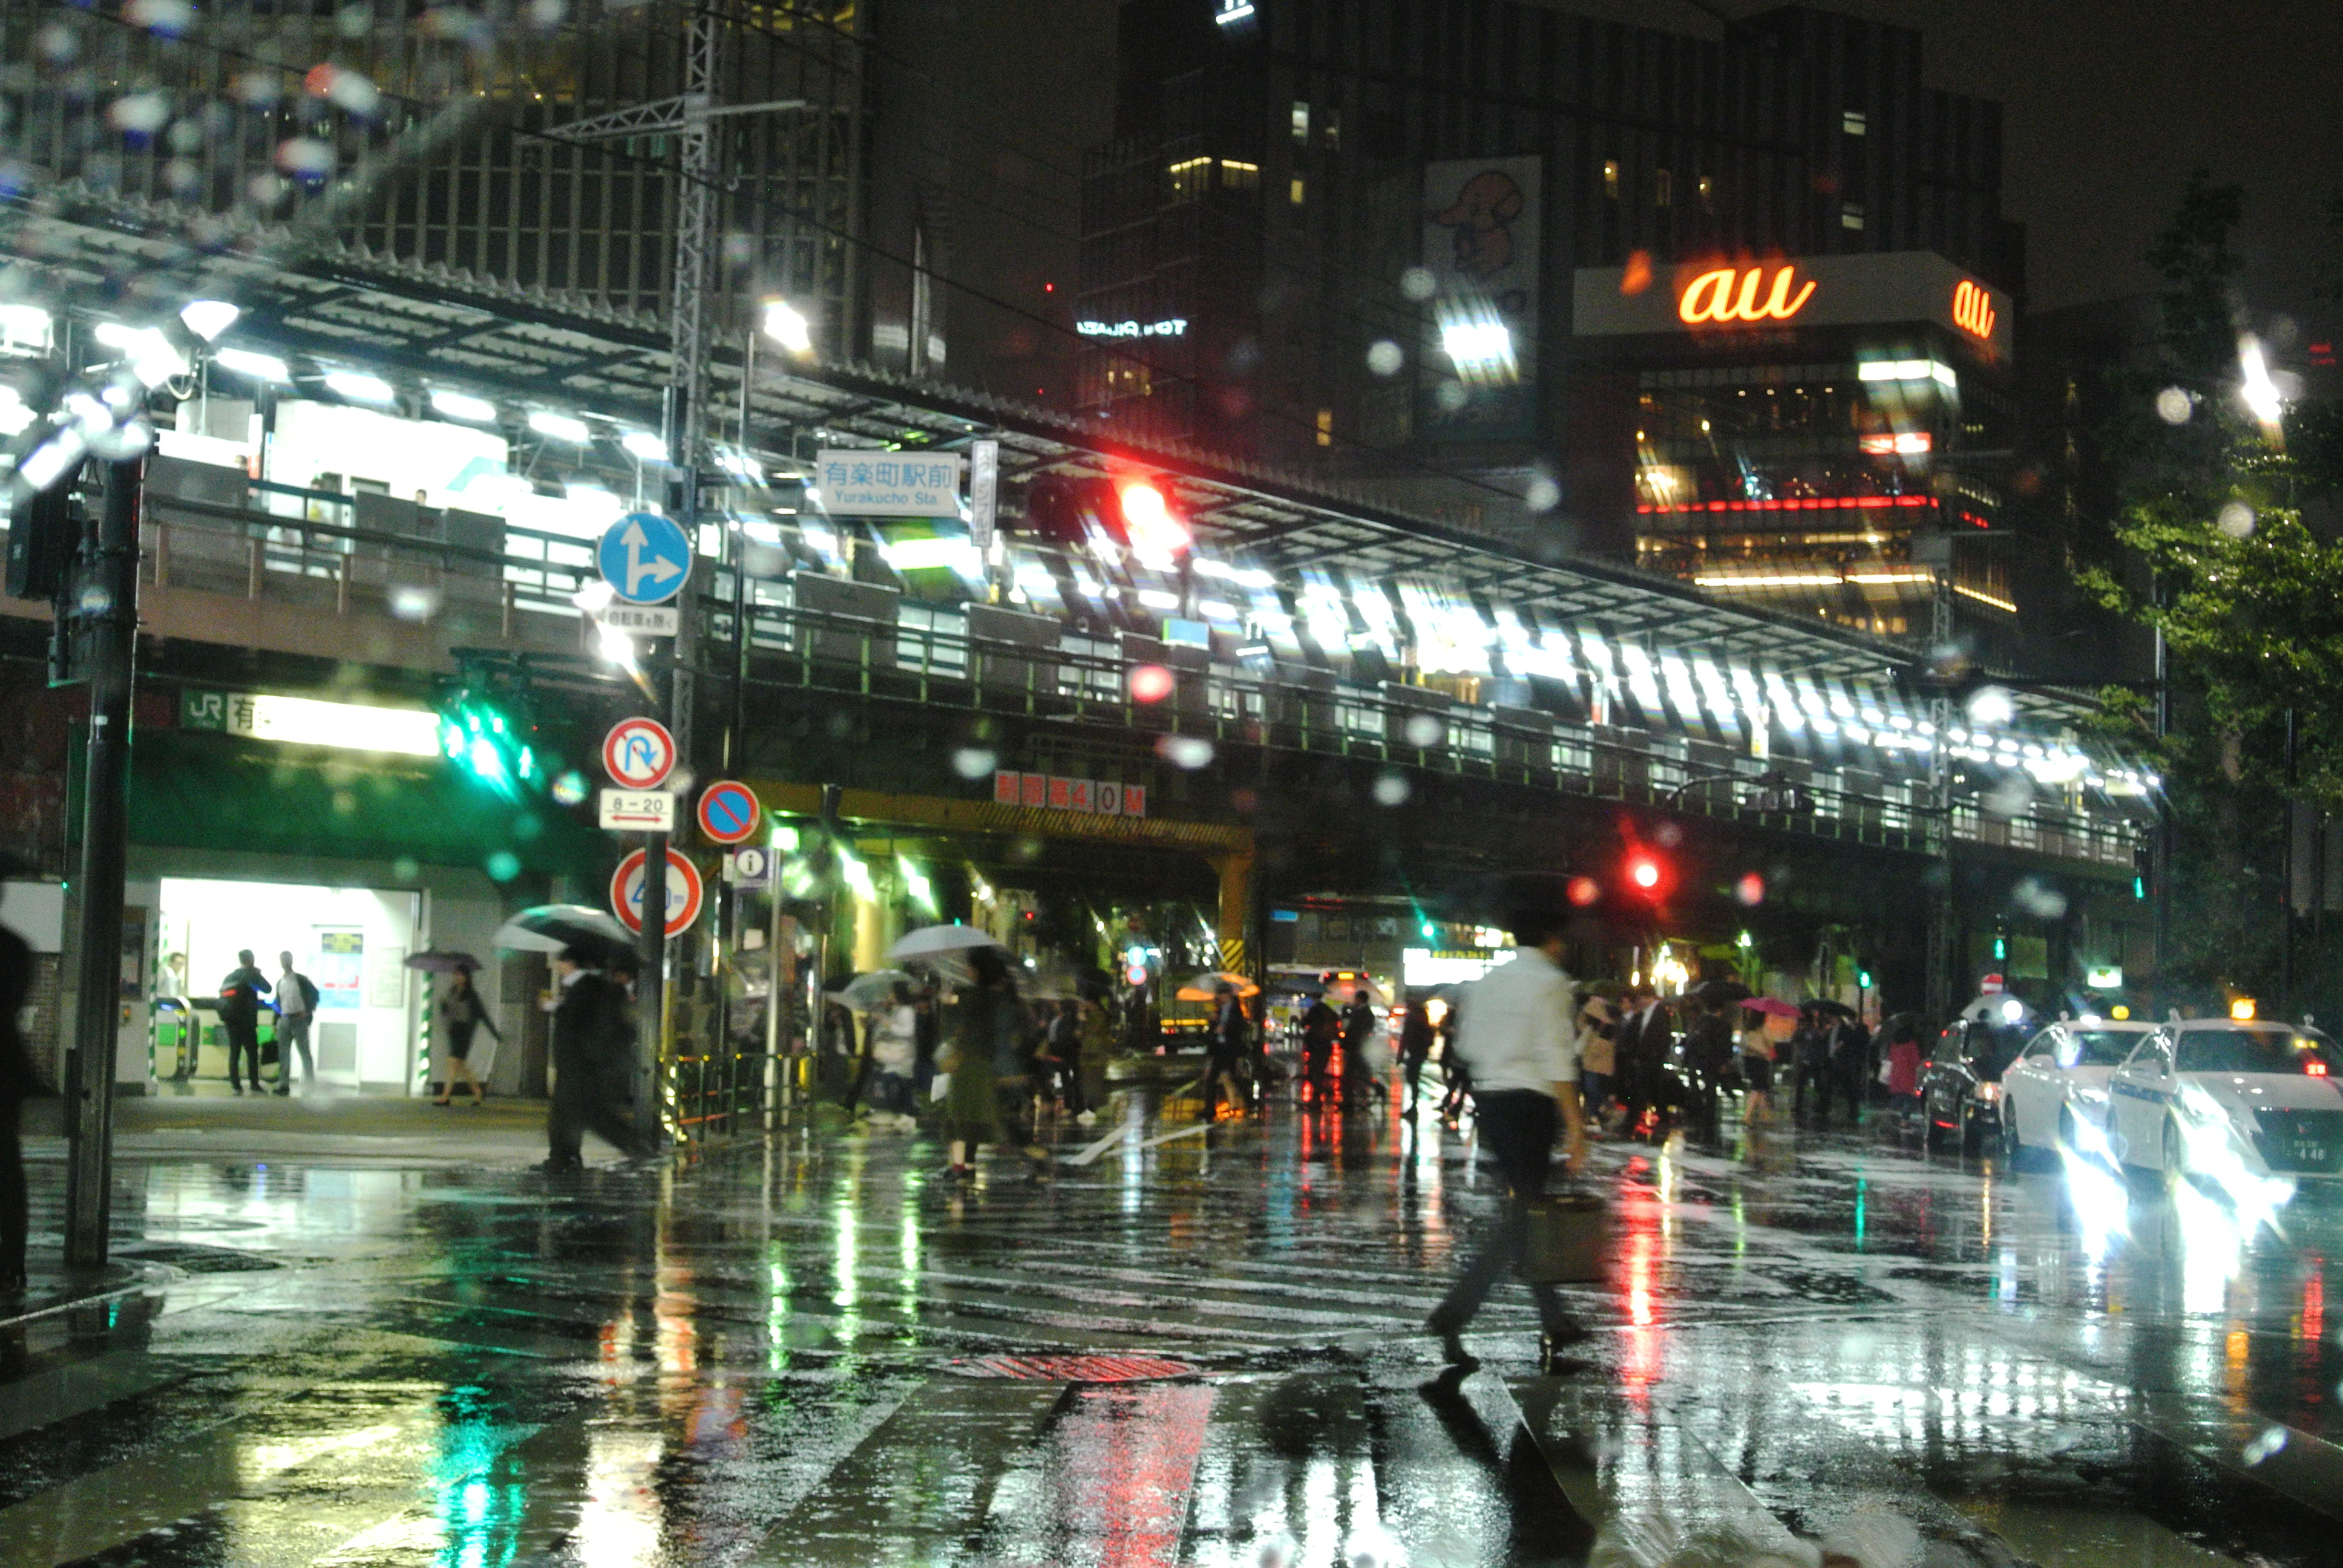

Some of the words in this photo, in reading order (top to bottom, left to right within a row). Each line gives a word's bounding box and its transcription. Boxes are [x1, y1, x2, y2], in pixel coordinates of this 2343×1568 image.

[1679, 266, 1816, 323] au
[1954, 280, 1994, 339] au
[824, 461, 952, 489] 有楽町駅前
[835, 490, 908, 505] Yurakucho
[189, 693, 222, 720] JR
